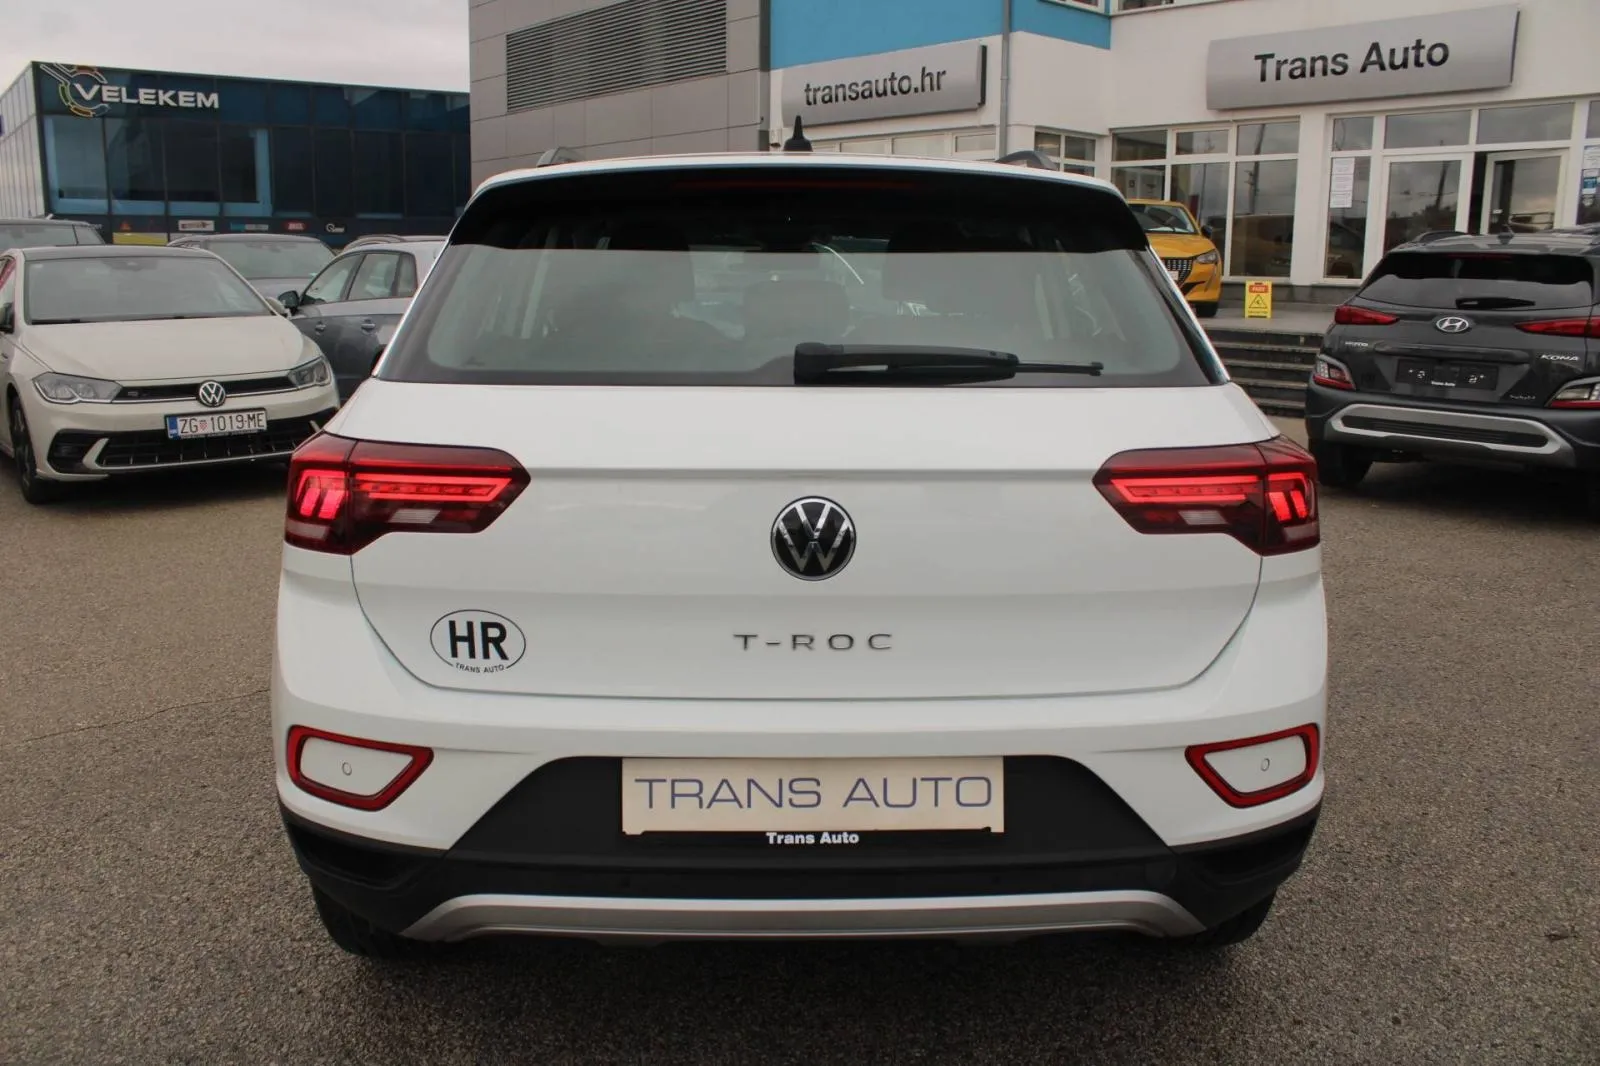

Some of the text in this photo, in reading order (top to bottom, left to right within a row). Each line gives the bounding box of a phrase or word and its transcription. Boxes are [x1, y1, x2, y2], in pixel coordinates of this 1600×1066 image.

[1254, 38, 1450, 82] Trans Auto
[74, 83, 219, 109] VELEKEM
[804, 66, 947, 106] transauto.hr
[179, 417, 198, 434] ZG
[448, 620, 509, 660] HR
[733, 633, 893, 651] T-ROC
[456, 662, 505, 673] TRANS AUTO
[634, 776, 992, 809] TRANS AUTO
[766, 831, 860, 845] Trans Auto
